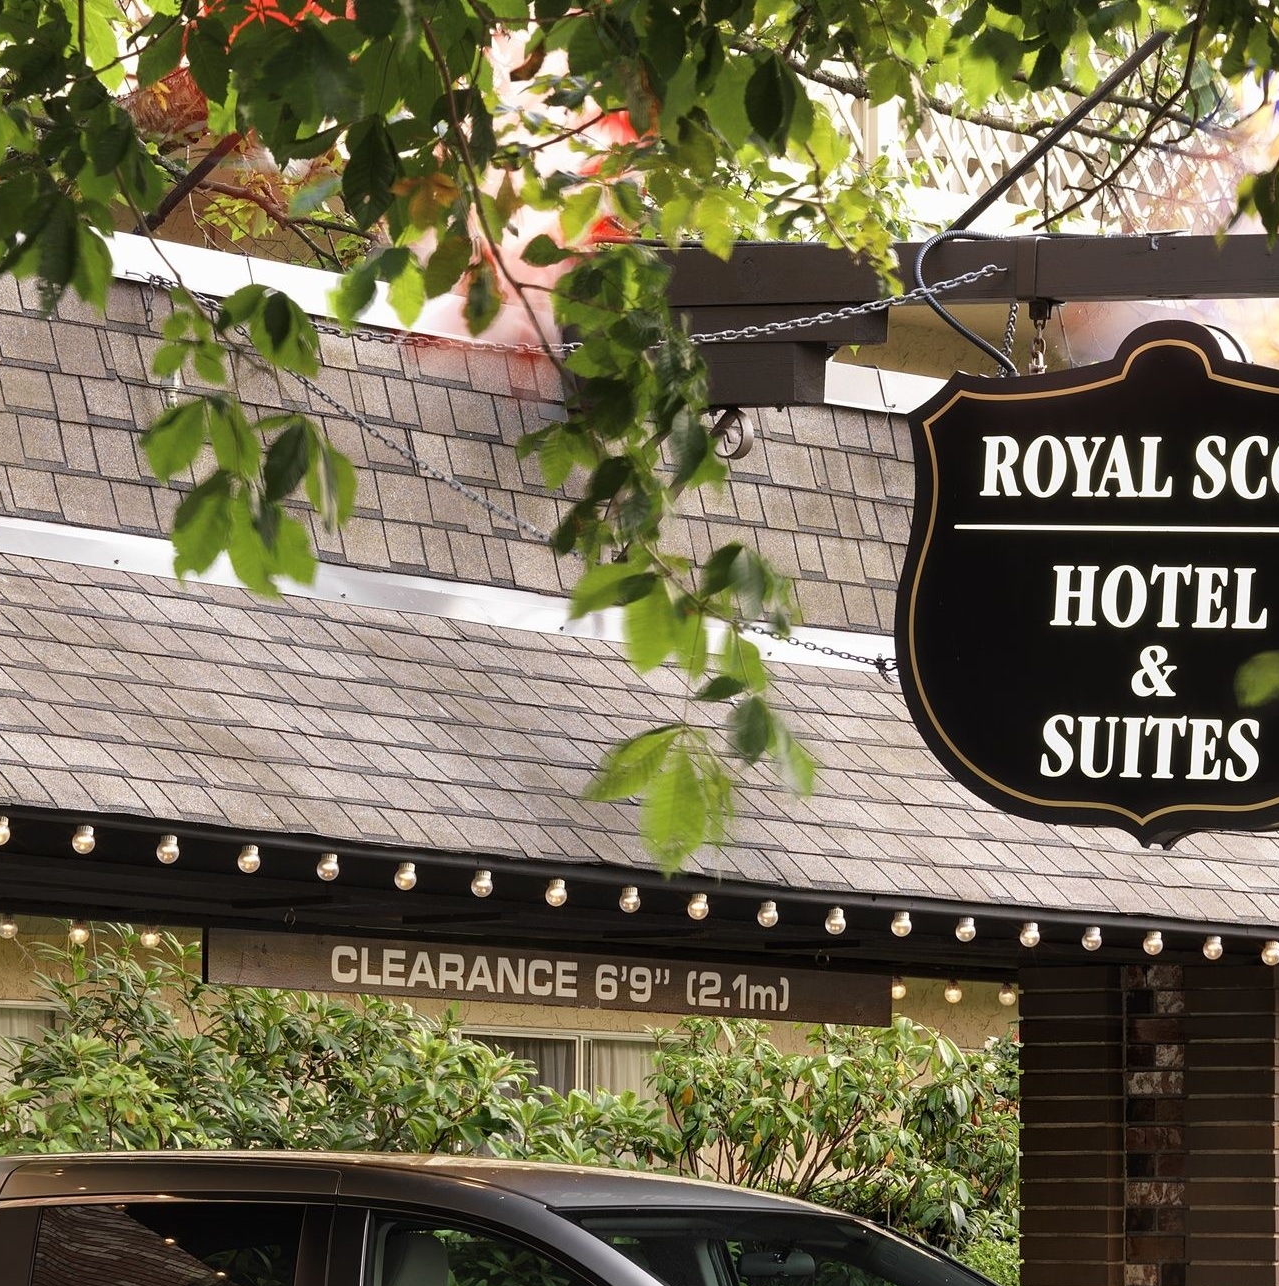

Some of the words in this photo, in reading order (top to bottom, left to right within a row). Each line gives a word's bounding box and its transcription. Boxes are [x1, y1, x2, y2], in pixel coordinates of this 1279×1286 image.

[979, 434, 1173, 499] ROYAL
[1049, 563, 1268, 630] HOTEL
[1130, 644, 1178, 698] &
[1039, 713, 1261, 782] SUITES
[331, 945, 578, 998] CLEARANCE
[686, 970, 790, 1012] (2.1m)
